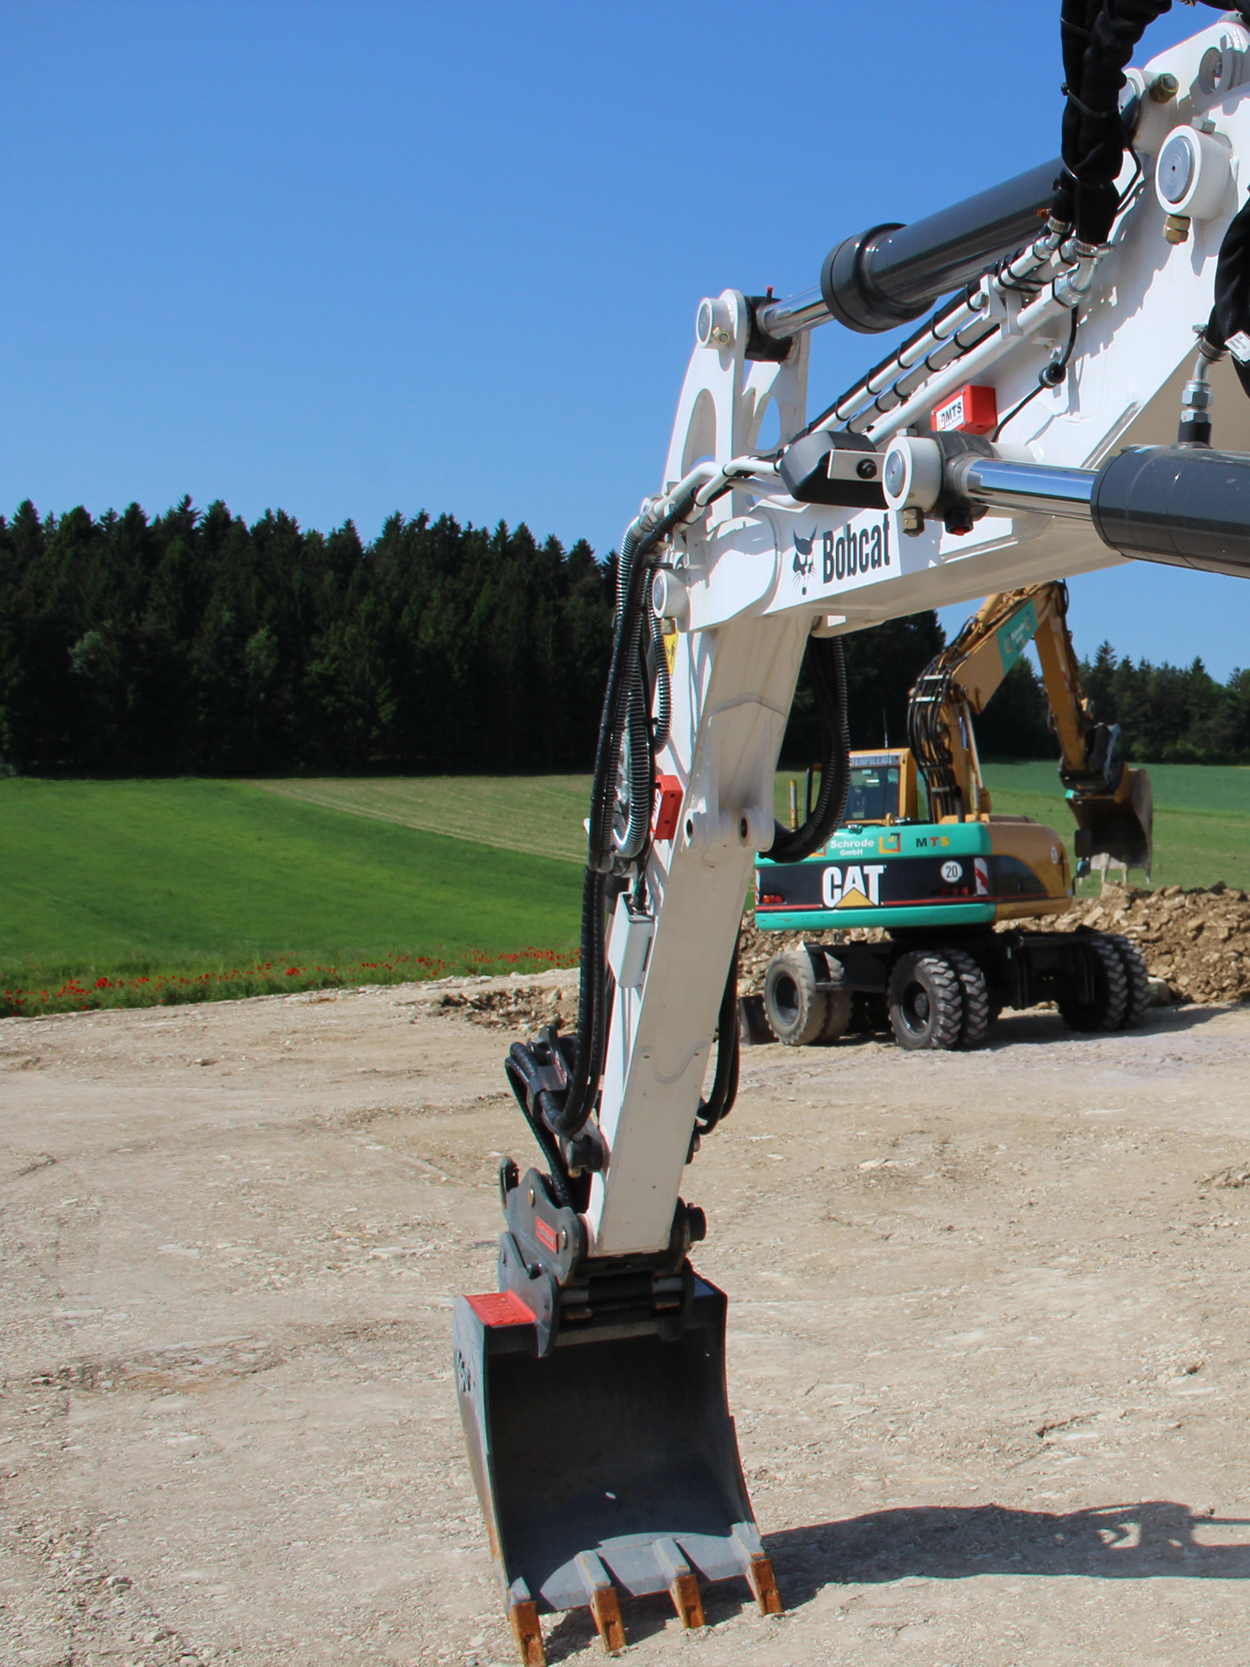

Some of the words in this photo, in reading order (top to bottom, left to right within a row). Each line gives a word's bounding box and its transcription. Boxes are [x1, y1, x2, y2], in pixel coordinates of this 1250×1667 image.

[945, 401, 962, 423] MTS
[823, 512, 891, 584] Bobcat
[851, 755, 892, 766] TERPILLAR
[830, 837, 875, 849] Schrode
[916, 836, 950, 847] MTS
[840, 848, 863, 857] GmbH
[945, 864, 959, 879] 20
[822, 864, 885, 908] CAT
